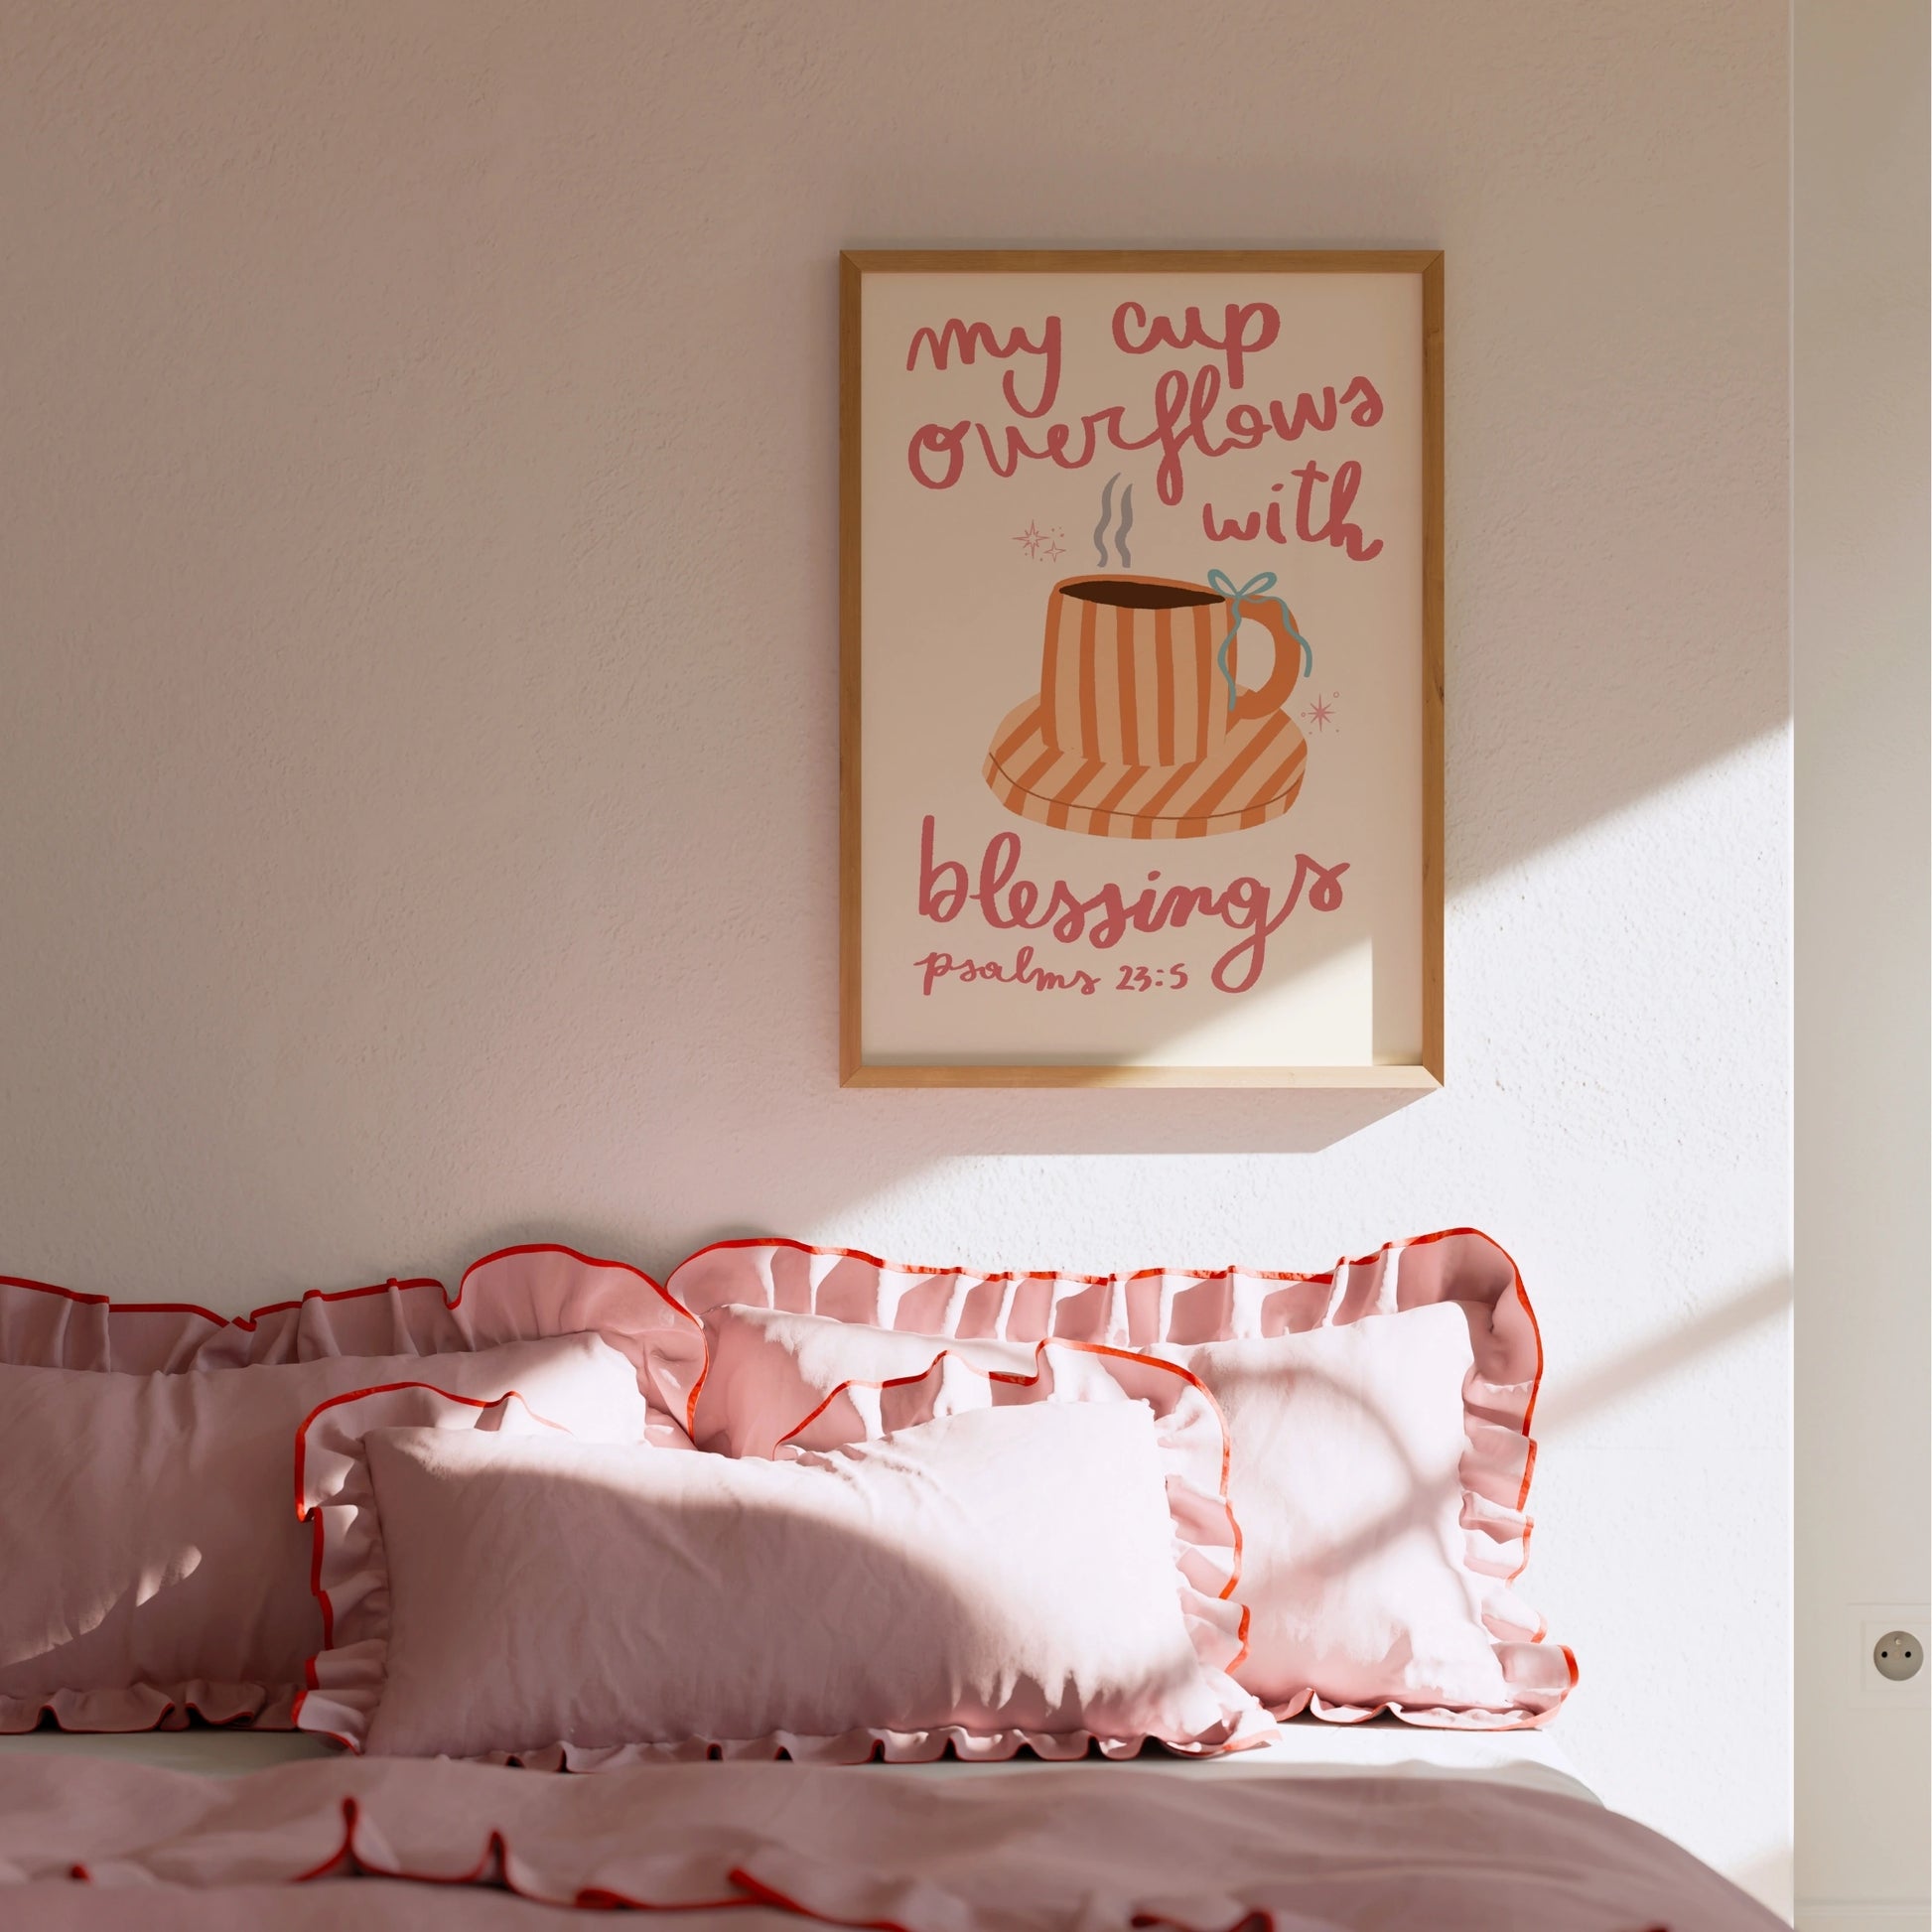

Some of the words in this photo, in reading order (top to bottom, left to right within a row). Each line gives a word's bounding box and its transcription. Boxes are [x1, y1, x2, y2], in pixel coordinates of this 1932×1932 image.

[905, 315, 1062, 419] my
[1111, 301, 1281, 390] cup
[907, 363, 1384, 506] overflows
[1202, 460, 1384, 562] with
[917, 814, 1351, 994] blessings
[913, 945, 1101, 996] psalms
[1115, 962, 1189, 992] 23:5
